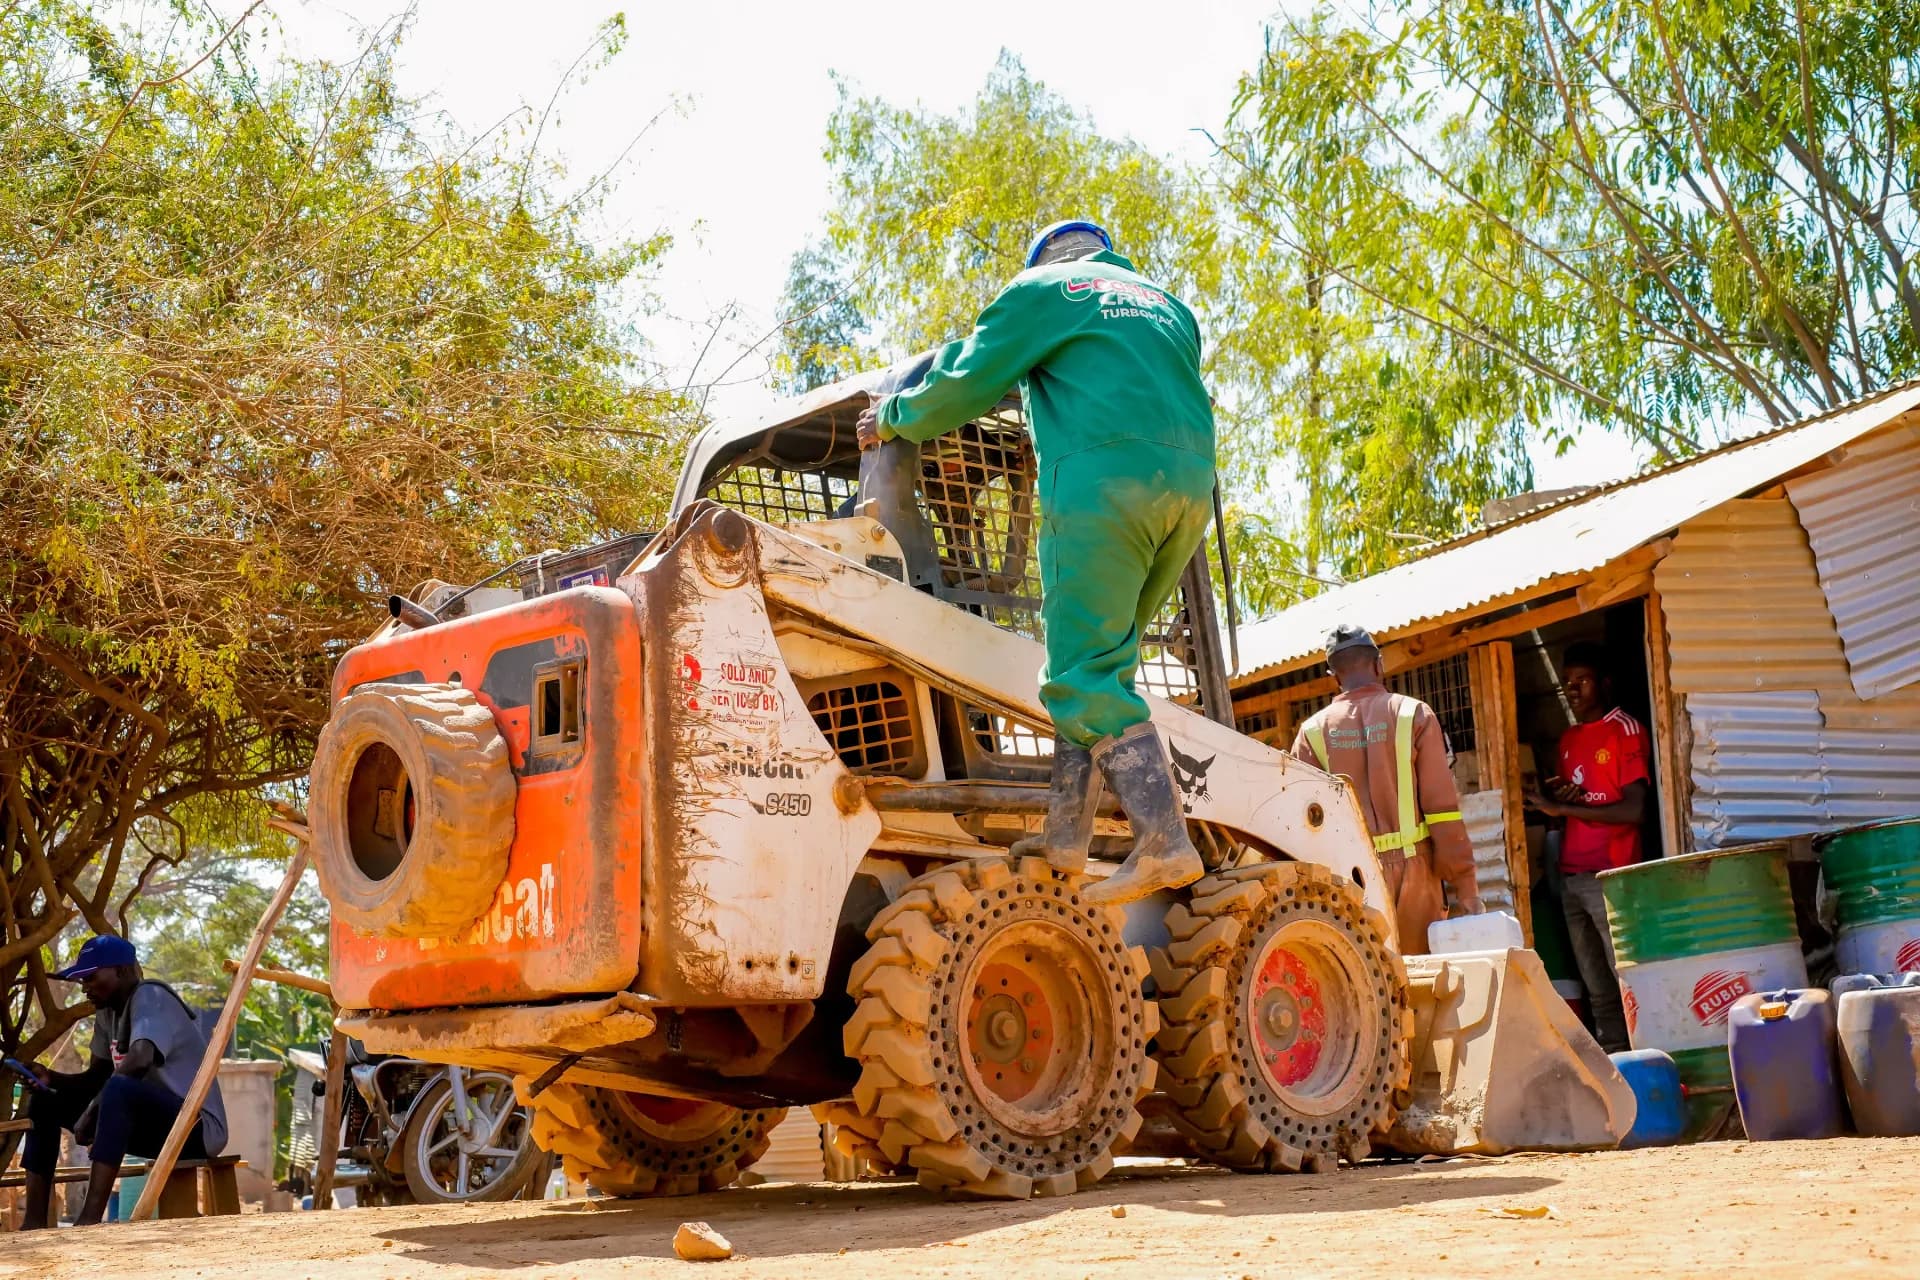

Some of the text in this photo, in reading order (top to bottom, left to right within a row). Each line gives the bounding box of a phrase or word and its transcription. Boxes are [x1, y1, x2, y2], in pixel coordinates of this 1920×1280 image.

[1101, 307, 1174, 327] TURBOMAX
[721, 662, 768, 684] SOLD AND
[765, 793, 811, 817] S450
[1700, 981, 1744, 1014] RUBIS
